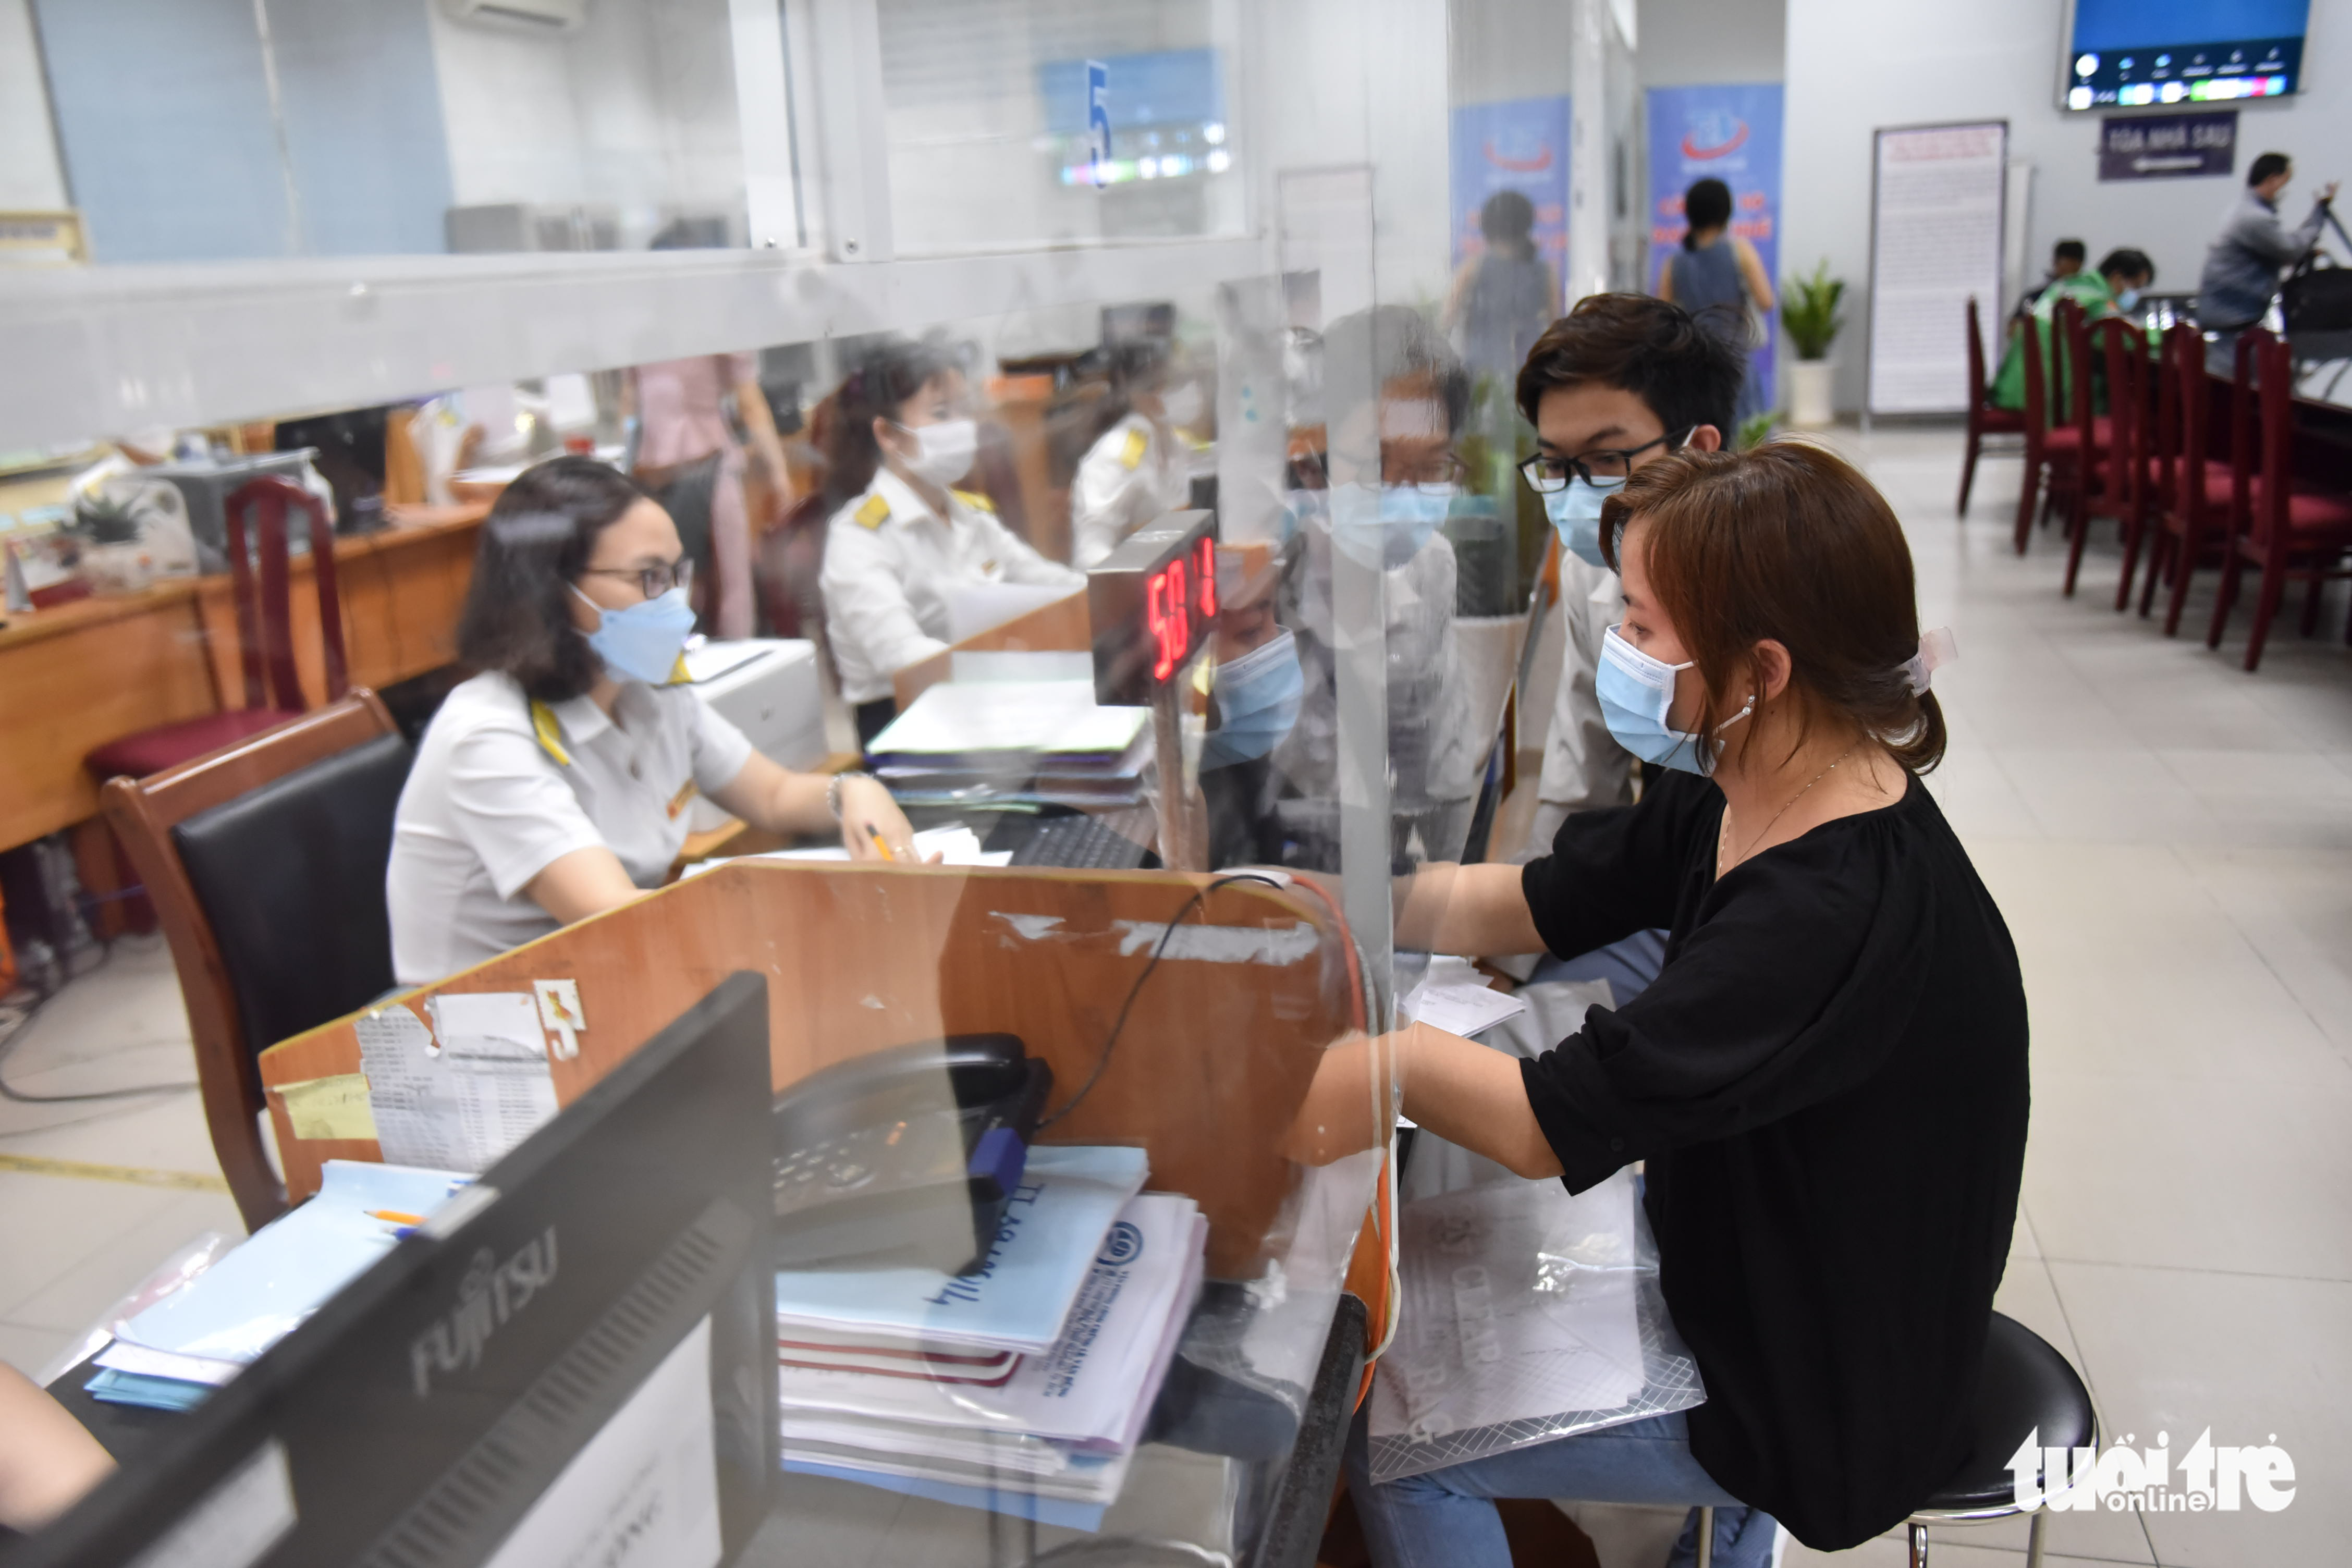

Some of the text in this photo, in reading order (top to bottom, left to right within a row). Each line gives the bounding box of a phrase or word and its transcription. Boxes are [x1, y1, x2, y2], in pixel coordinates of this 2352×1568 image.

[2191, 122, 2231, 149] SAU
[413, 1223, 558, 1399] FUJITSU
[1406, 1357, 1454, 1446] BAG
